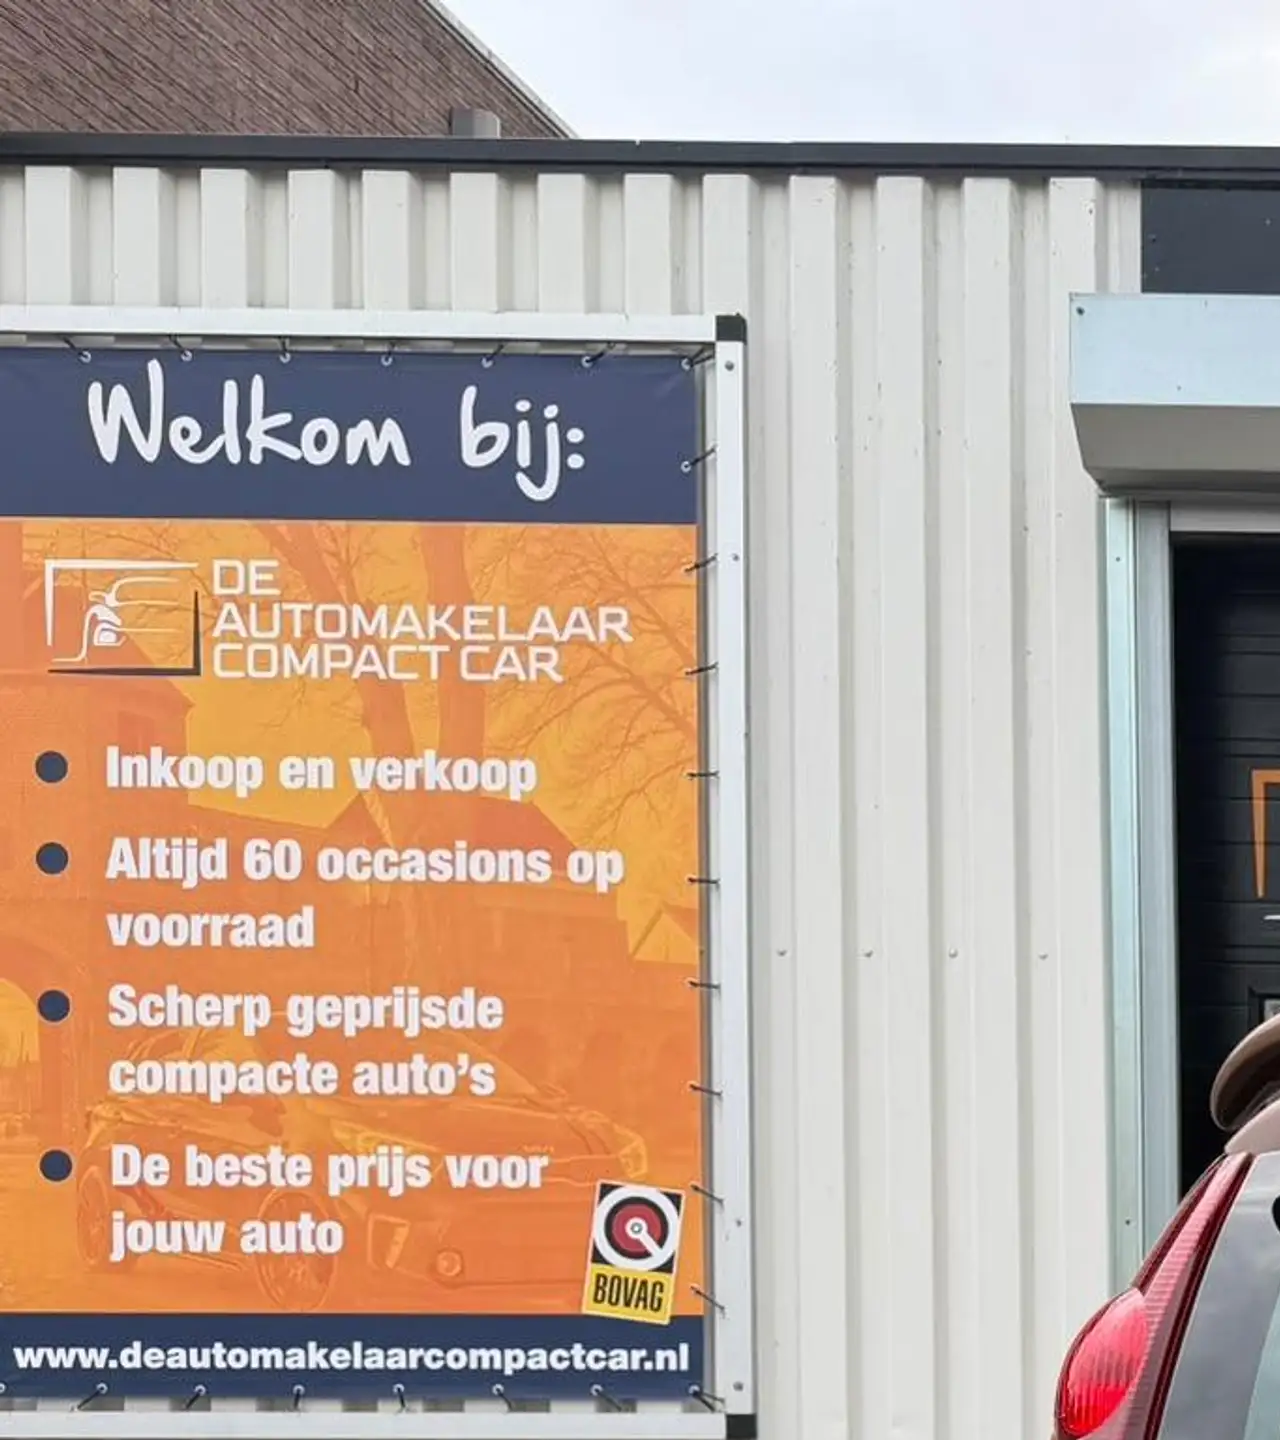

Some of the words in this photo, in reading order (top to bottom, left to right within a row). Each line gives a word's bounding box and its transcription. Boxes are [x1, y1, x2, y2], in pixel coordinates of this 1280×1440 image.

[87, 358, 411, 466] Welkom
[460, 385, 585, 501] bij:
[213, 559, 280, 596] DE
[212, 602, 633, 645] AUTOMAKELAAR
[213, 643, 443, 680] COMPACT
[460, 645, 563, 683] CAR
[106, 746, 264, 798] Inkoop
[279, 757, 335, 789] en
[350, 750, 537, 802] verkoop
[105, 837, 228, 889] Altijd
[243, 838, 302, 881] 60
[317, 840, 552, 883] occasions
[567, 850, 624, 893] op
[107, 906, 314, 948] voorraad
[109, 984, 271, 1036] Scherp
[286, 986, 503, 1038] geprijsde
[109, 1053, 338, 1103] compacte
[352, 1054, 496, 1096] auto's
[111, 1144, 170, 1186] De
[186, 1145, 312, 1187] beste
[328, 1146, 431, 1197] prijs
[445, 1155, 549, 1188] voor
[110, 1211, 225, 1262] jouw
[240, 1213, 343, 1254] auto
[594, 1275, 663, 1311] BOVAG
[12, 1340, 689, 1376] www.deautomakelaarcompactcar.nl
